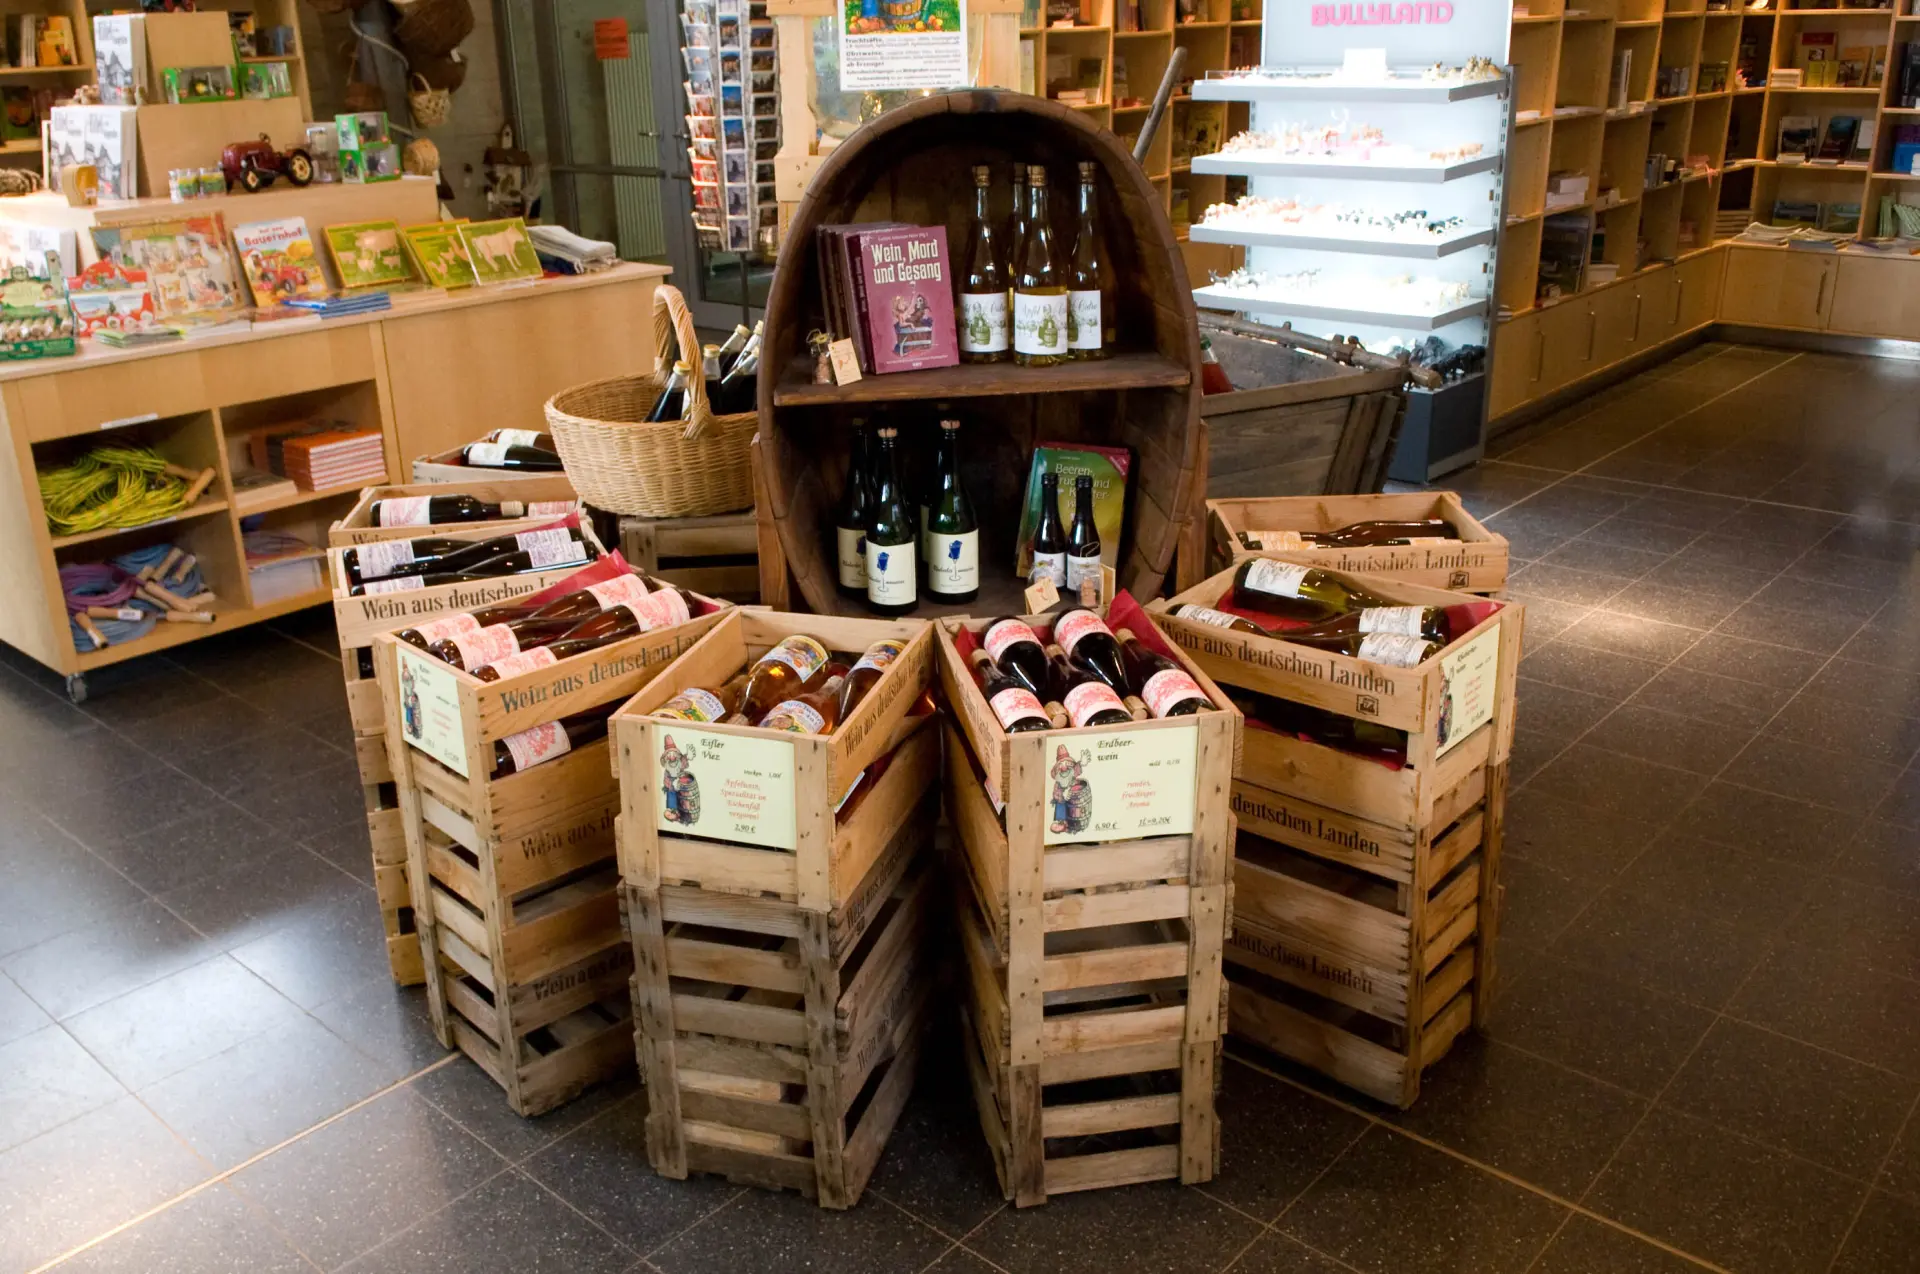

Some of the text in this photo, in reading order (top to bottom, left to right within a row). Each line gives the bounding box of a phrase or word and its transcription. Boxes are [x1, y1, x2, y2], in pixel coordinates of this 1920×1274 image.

[1311, 1, 1453, 27] BULLYLAND
[244, 227, 302, 246] Bauernhof
[871, 239, 939, 266] Wein, Mord
[873, 262, 942, 284] und Gesang
[361, 599, 406, 621] Wein
[412, 595, 444, 614] aus
[1160, 621, 1395, 696] Wein aus deutschen Landen
[501, 684, 548, 714] Wein
[552, 671, 584, 698] aus
[589, 644, 671, 685] deutschen
[700, 738, 725, 750] Eifler
[702, 751, 721, 761] Viez
[1097, 738, 1135, 749] Erdbeer-
[1097, 753, 1118, 762] wein
[1232, 793, 1380, 858] deutschen Landen
[521, 820, 597, 861] Wein aus
[532, 973, 576, 1001] Wein
[1312, 955, 1373, 995] Landen
